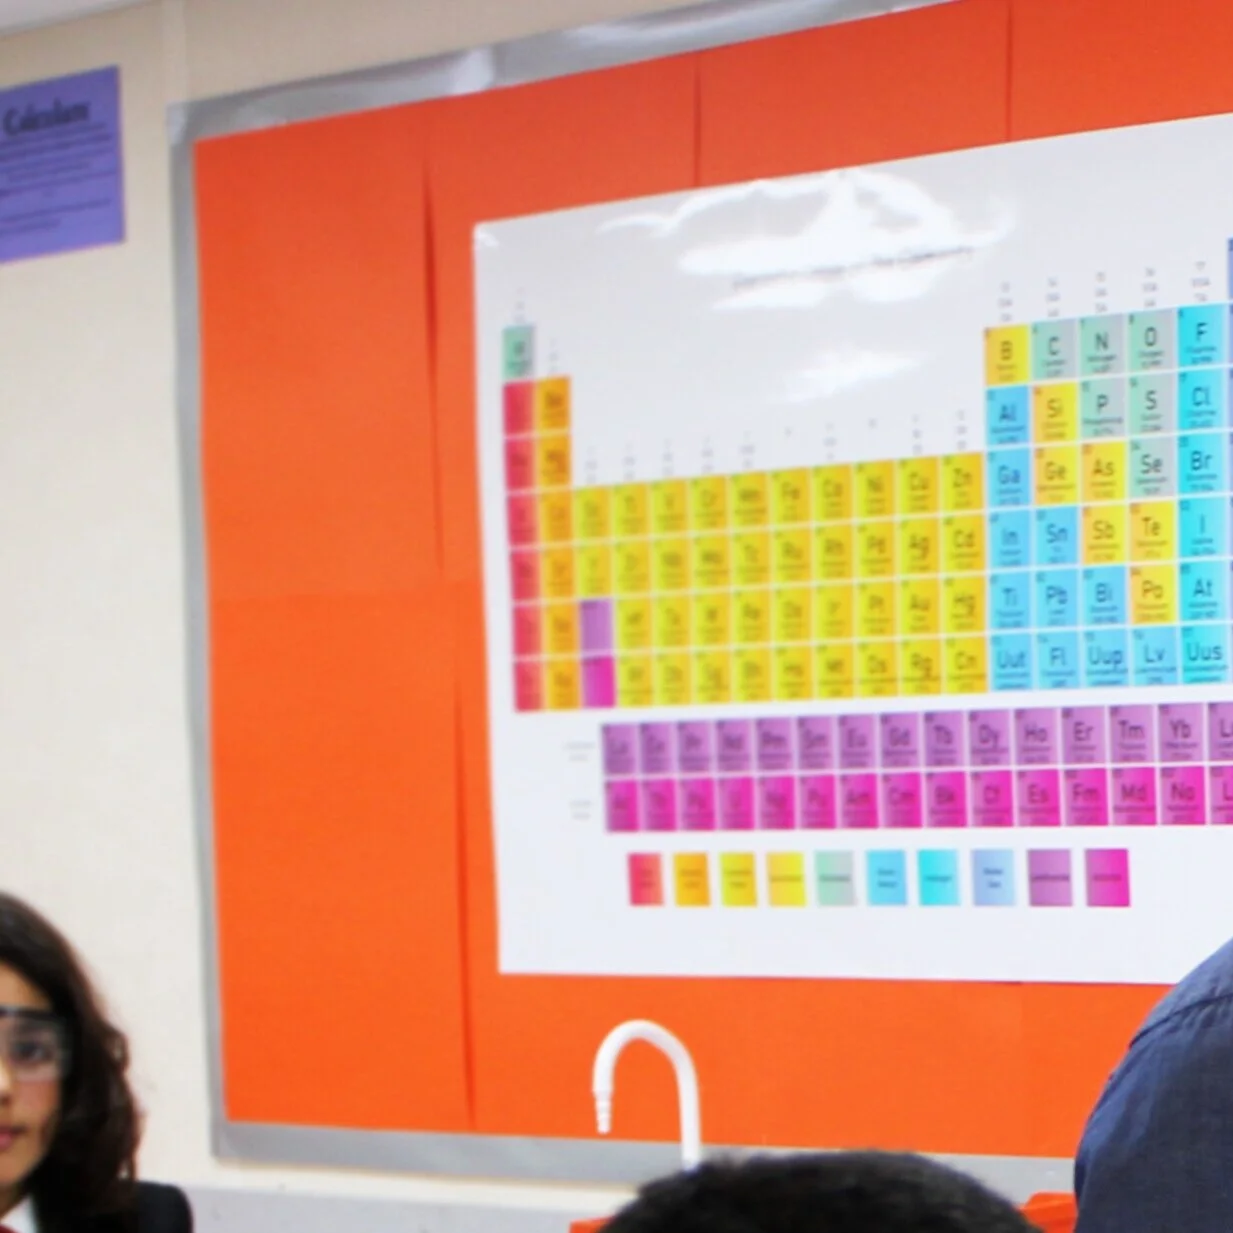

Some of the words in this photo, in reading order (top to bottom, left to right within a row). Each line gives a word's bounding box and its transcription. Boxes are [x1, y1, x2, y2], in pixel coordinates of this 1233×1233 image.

[1048, 337, 1059, 355] C
[1095, 333, 1109, 350] N
[1196, 322, 1208, 341] F
[1096, 395, 1109, 412] P
[1146, 390, 1157, 409] S
[1141, 455, 1162, 473] Se
[1191, 452, 1212, 470] Br
[1188, 643, 1223, 661] Uus
[1169, 720, 1191, 738] Yb
